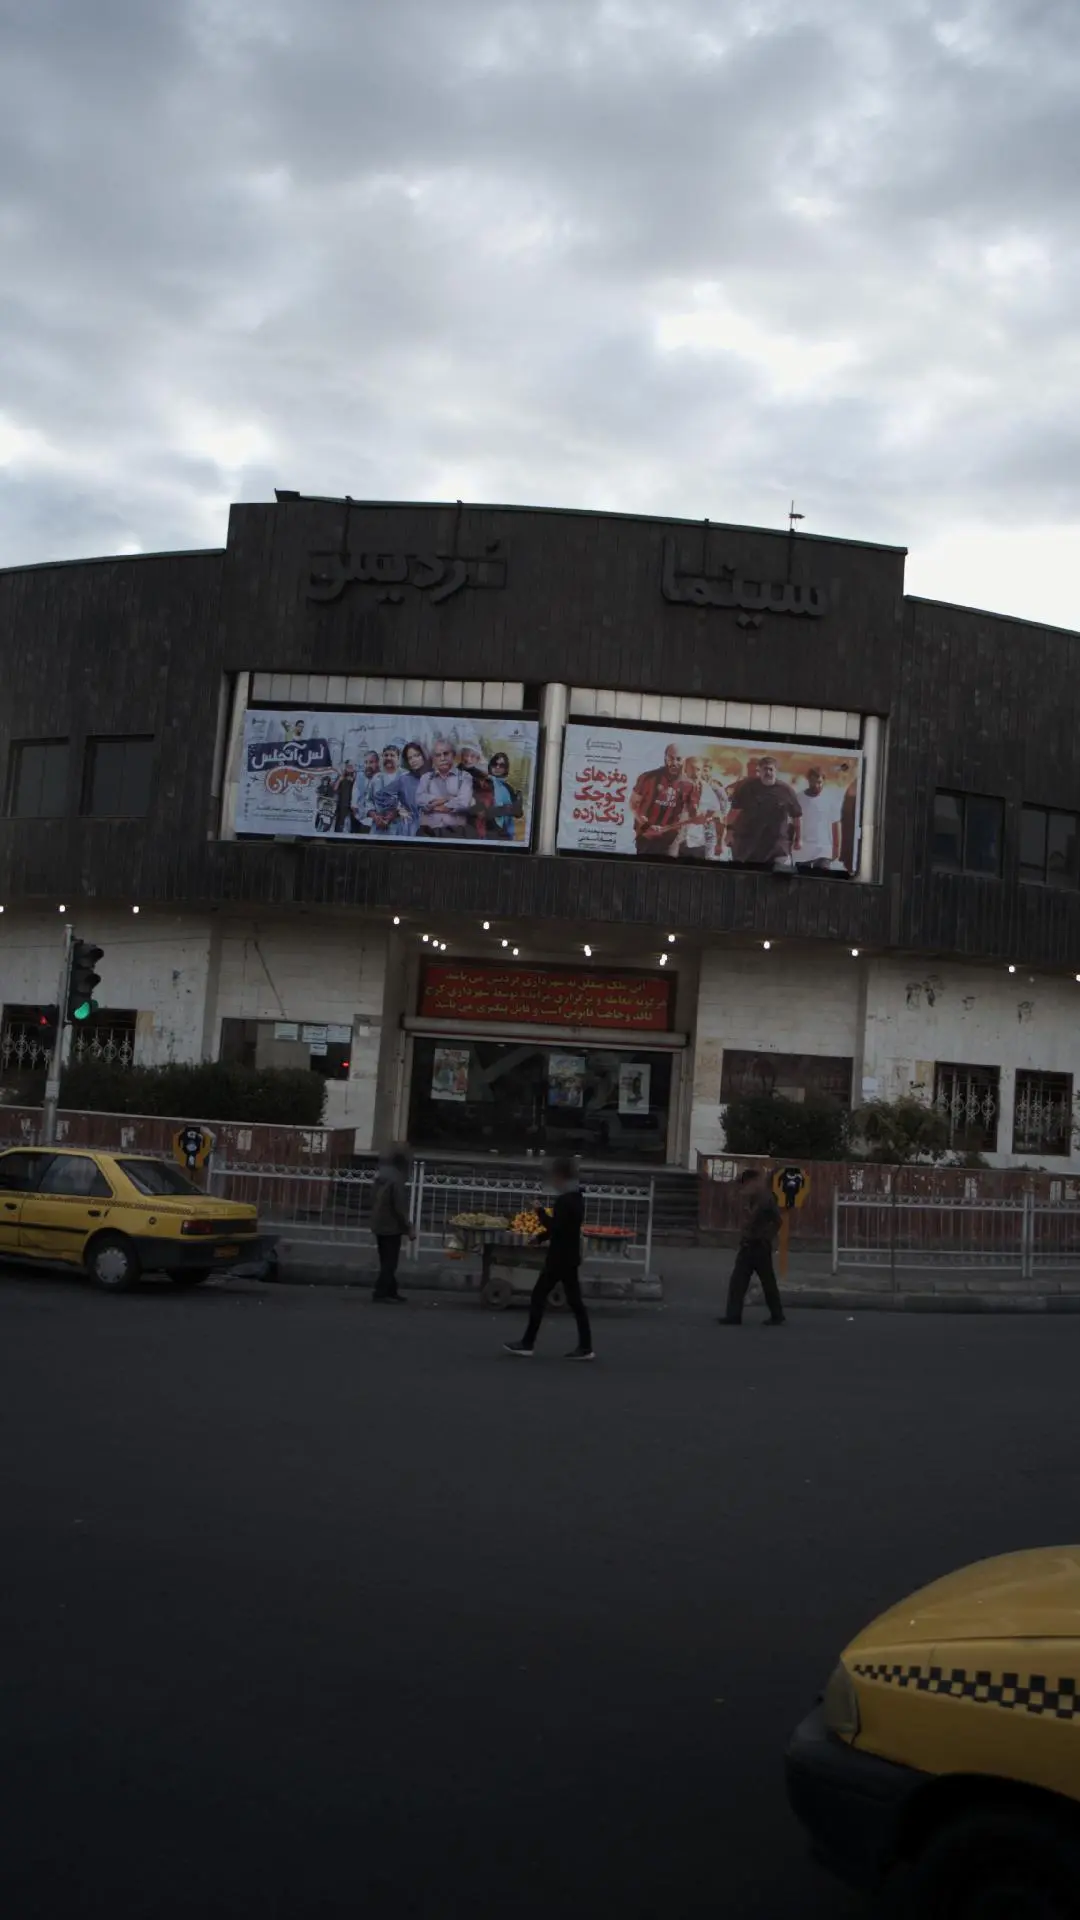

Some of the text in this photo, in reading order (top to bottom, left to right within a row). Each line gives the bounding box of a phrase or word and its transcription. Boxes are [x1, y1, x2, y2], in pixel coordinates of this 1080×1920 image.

[306, 535, 825, 630] سینما ردیس
[251, 741, 325, 770] لس آنجلس
[575, 764, 628, 788] مغزهای
[574, 784, 628, 808] کوچک
[486, 974, 520, 987] فردیس
[567, 978, 576, 987] به
[577, 978, 605, 991] متعلق
[606, 980, 629, 991] ملک
[629, 980, 647, 994] این
[425, 983, 446, 996] کرج
[447, 985, 490, 998] شهرداری
[493, 987, 518, 1000] توسط
[603, 994, 634, 1005] معامله
[509, 1001, 531, 1015] قابل
[541, 1006, 562, 1015] است
[563, 1007, 594, 1019] قانونی
[632, 1010, 653, 1021] فاقد
